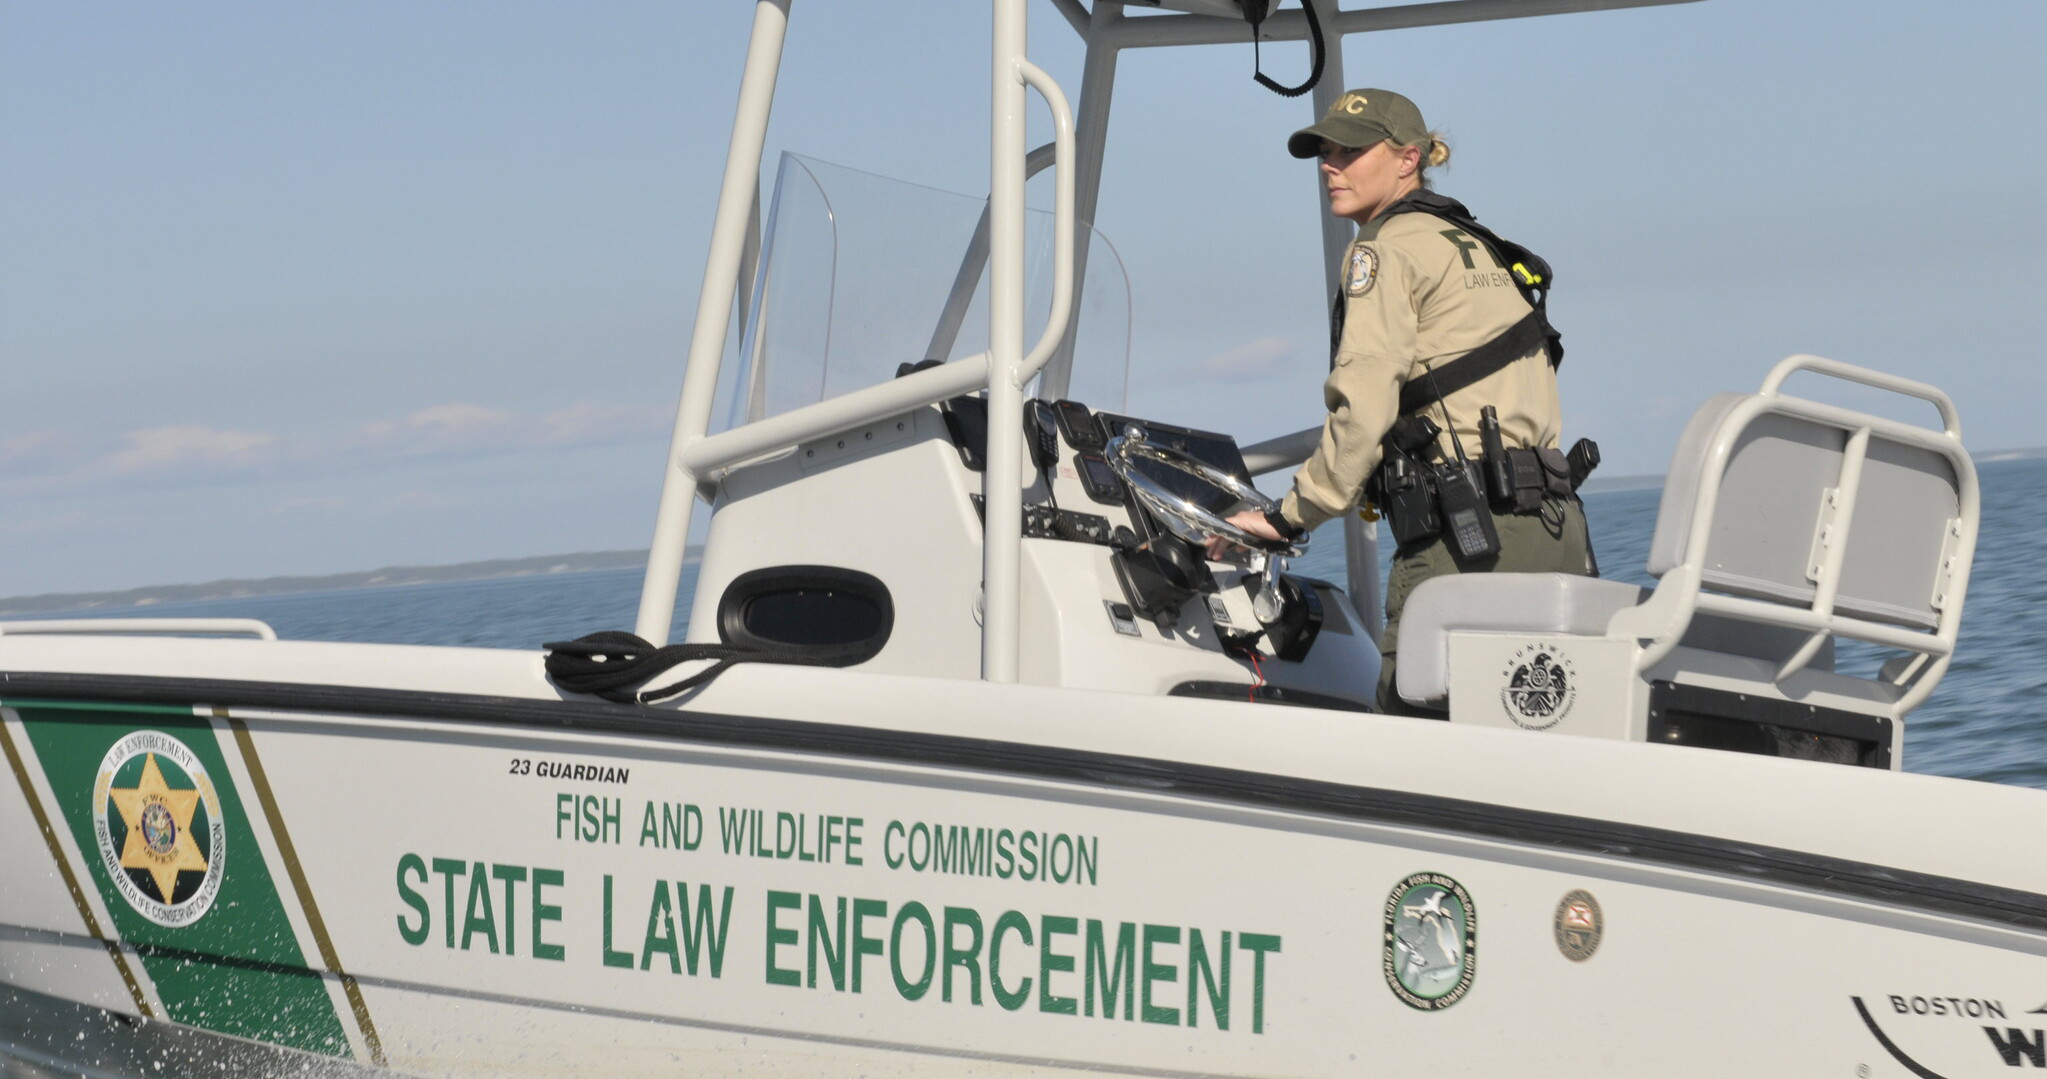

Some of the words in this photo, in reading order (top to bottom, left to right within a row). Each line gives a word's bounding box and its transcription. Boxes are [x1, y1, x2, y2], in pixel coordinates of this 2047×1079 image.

[1463, 272, 1491, 290] LAW
[108, 743, 125, 768] LAW
[125, 735, 193, 767] ENFORCEMENT
[508, 758, 531, 775] 23
[536, 761, 630, 785] GUARDIAN
[556, 793, 621, 844] FISH
[640, 801, 703, 851] AND
[719, 807, 864, 866] WILDLIFE
[885, 819, 1098, 886] COMMISSION
[96, 820, 110, 847] FISH
[103, 848, 119, 874] AND
[116, 871, 151, 914] WILDLIFE
[204, 823, 223, 896] COMMISSION
[396, 852, 565, 962] STATE
[603, 874, 735, 979] LAW
[766, 889, 1282, 1035] ENFORCEMENT
[1888, 995, 2007, 1019] BOSTON
